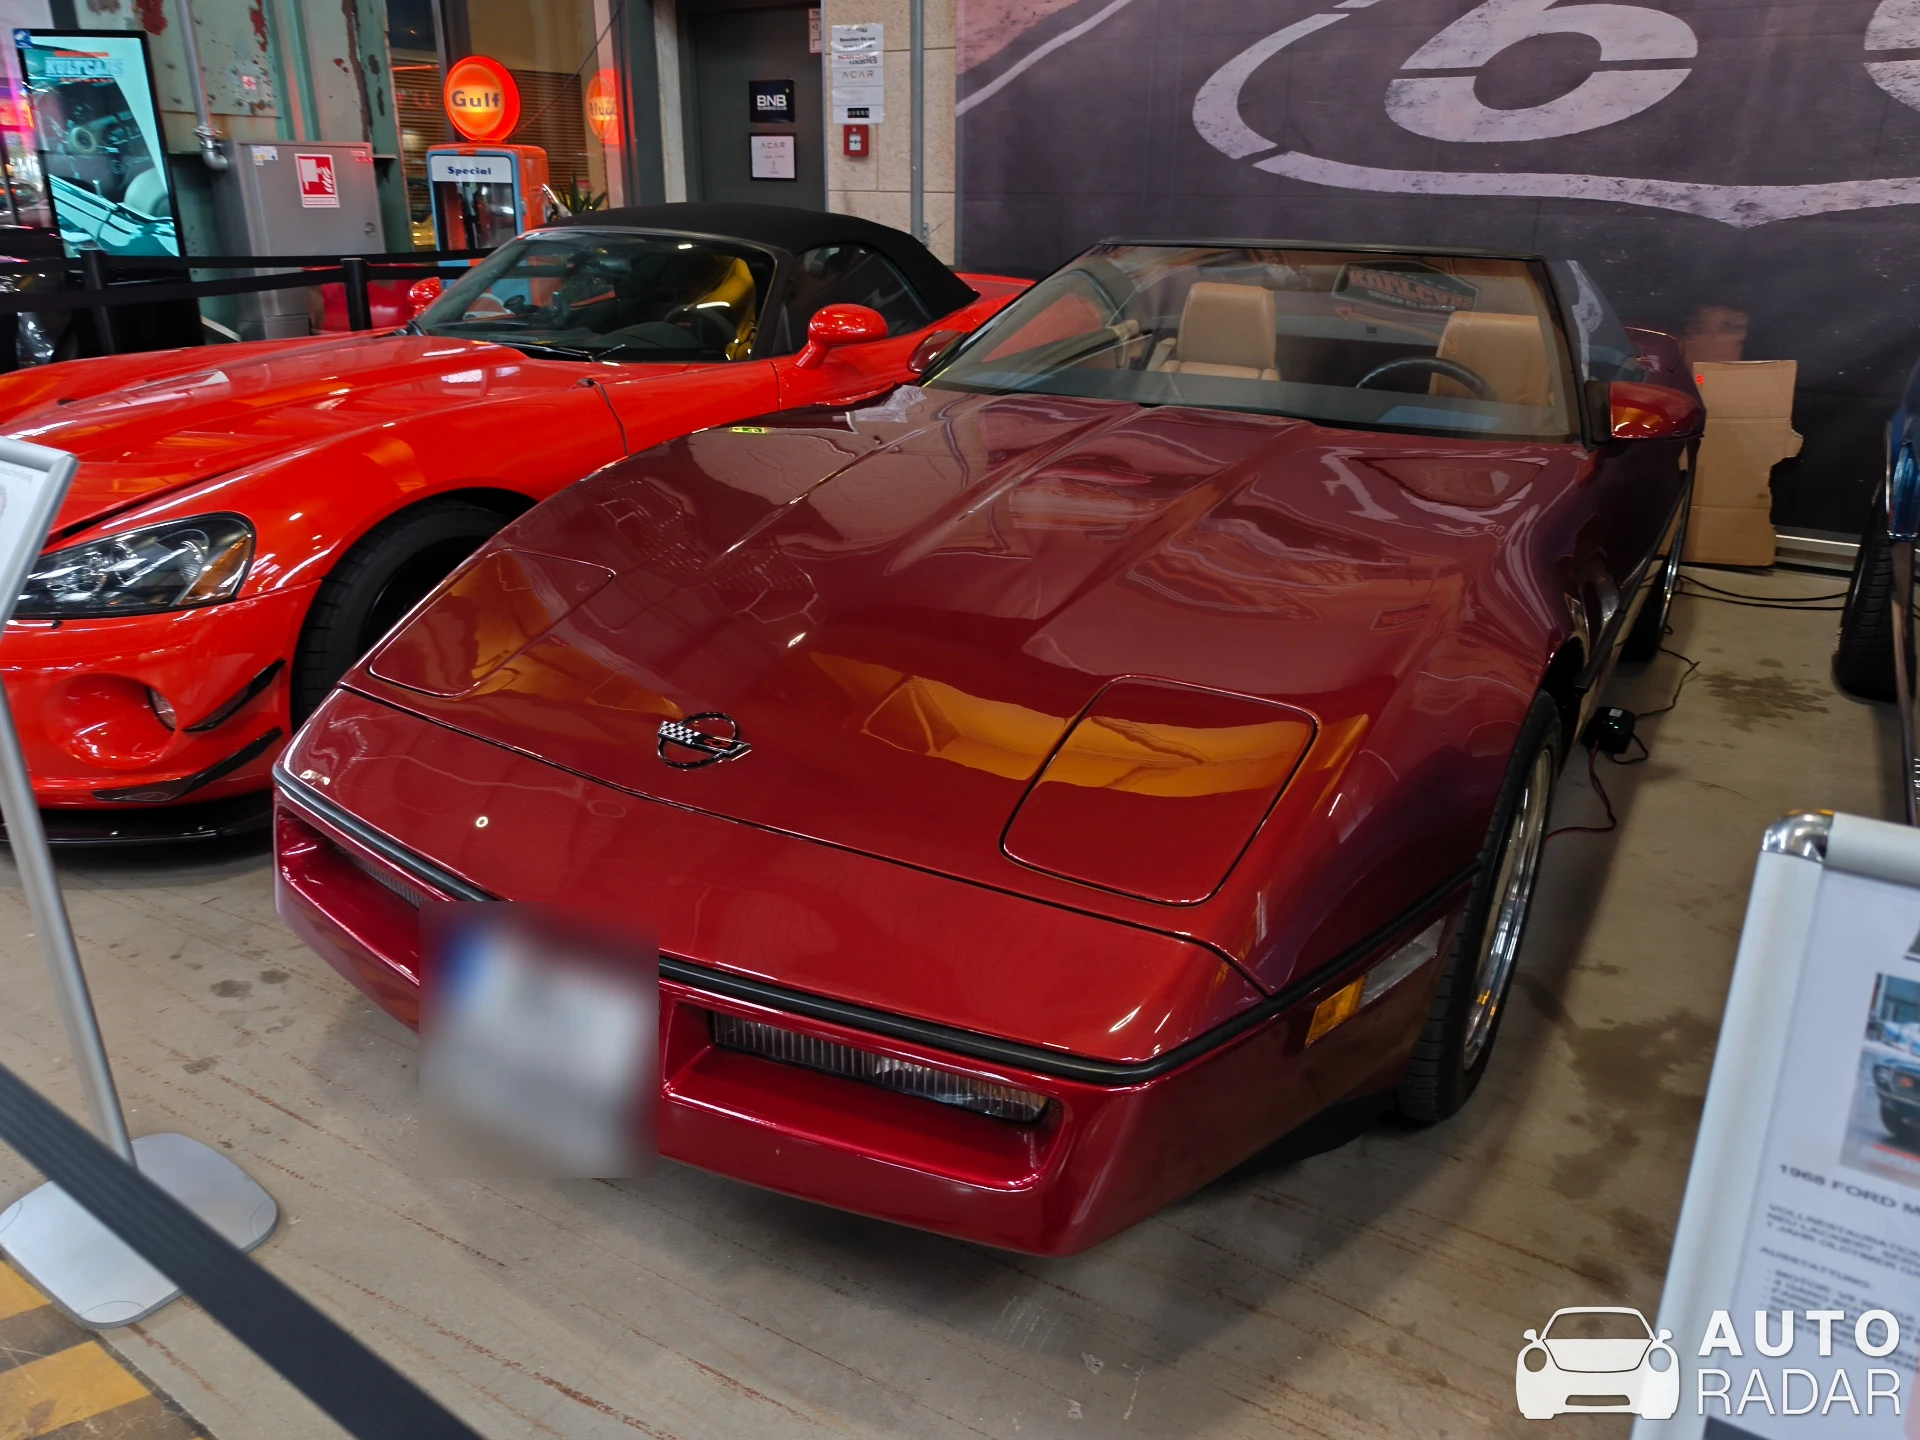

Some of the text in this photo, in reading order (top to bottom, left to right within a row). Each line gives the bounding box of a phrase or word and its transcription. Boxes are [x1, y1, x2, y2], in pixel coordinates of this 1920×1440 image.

[842, 70, 874, 79] ACAR
[451, 90, 500, 108] Gulf
[756, 94, 787, 107] BNB
[447, 166, 492, 176] Special
[1779, 1163, 1826, 1186] 1968
[1831, 1179, 1897, 1209] FORD
